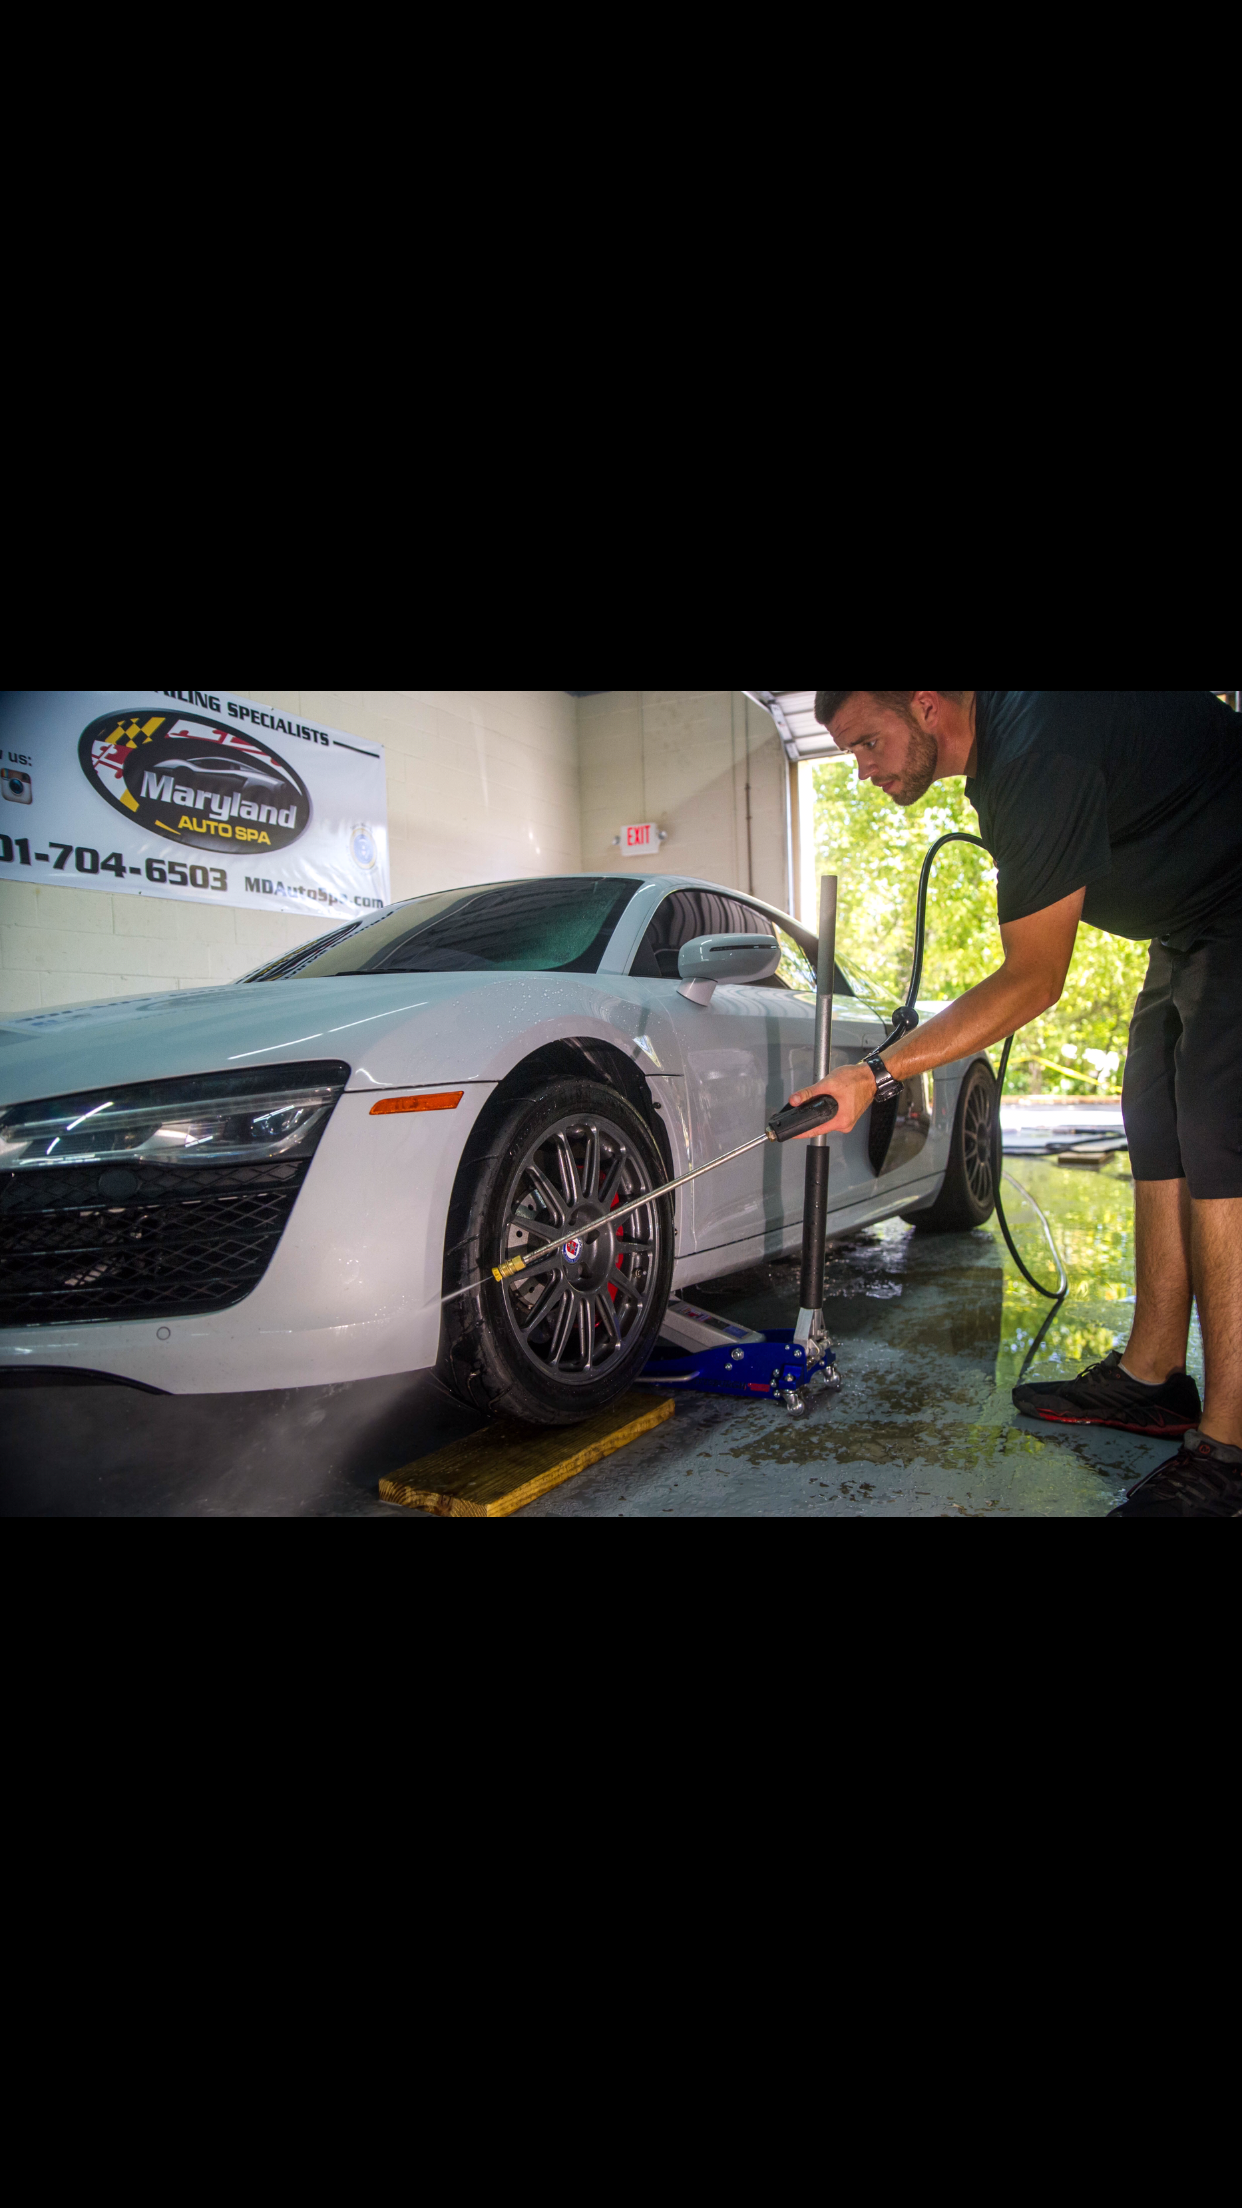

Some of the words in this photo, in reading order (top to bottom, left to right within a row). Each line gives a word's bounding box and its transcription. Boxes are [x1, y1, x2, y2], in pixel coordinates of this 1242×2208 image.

[227, 702, 330, 746] SPECIALISTS
[8, 751, 32, 767] us:
[140, 770, 297, 829] Maryland
[177, 815, 233, 838] AUTO
[235, 826, 272, 845] SPA
[627, 824, 651, 846] EXIT
